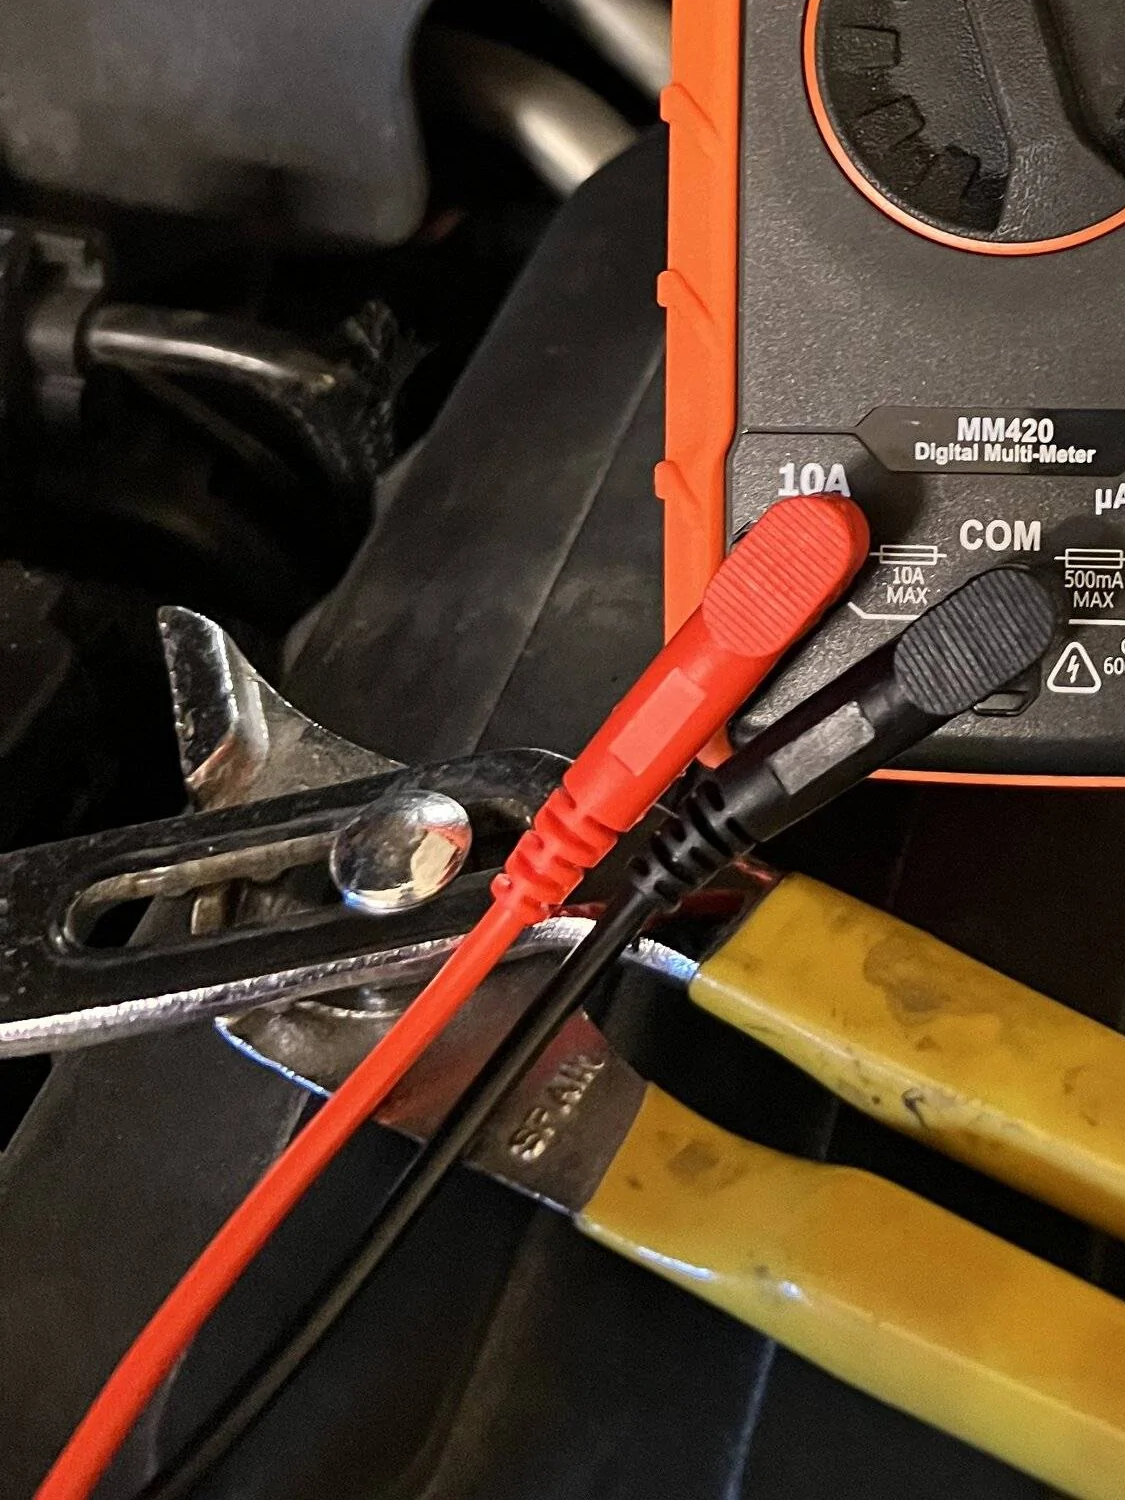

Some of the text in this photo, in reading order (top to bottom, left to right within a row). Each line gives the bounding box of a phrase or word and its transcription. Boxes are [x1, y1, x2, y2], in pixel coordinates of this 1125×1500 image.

[957, 417, 1054, 443] MM420
[914, 442, 1096, 465] Digital Multi-Meter
[778, 462, 851, 497] 10A
[959, 519, 1042, 552] COM
[892, 568, 924, 585] 10A
[1064, 570, 1124, 590] 500mA
[886, 587, 928, 605] MAX
[1073, 591, 1115, 609] MAX
